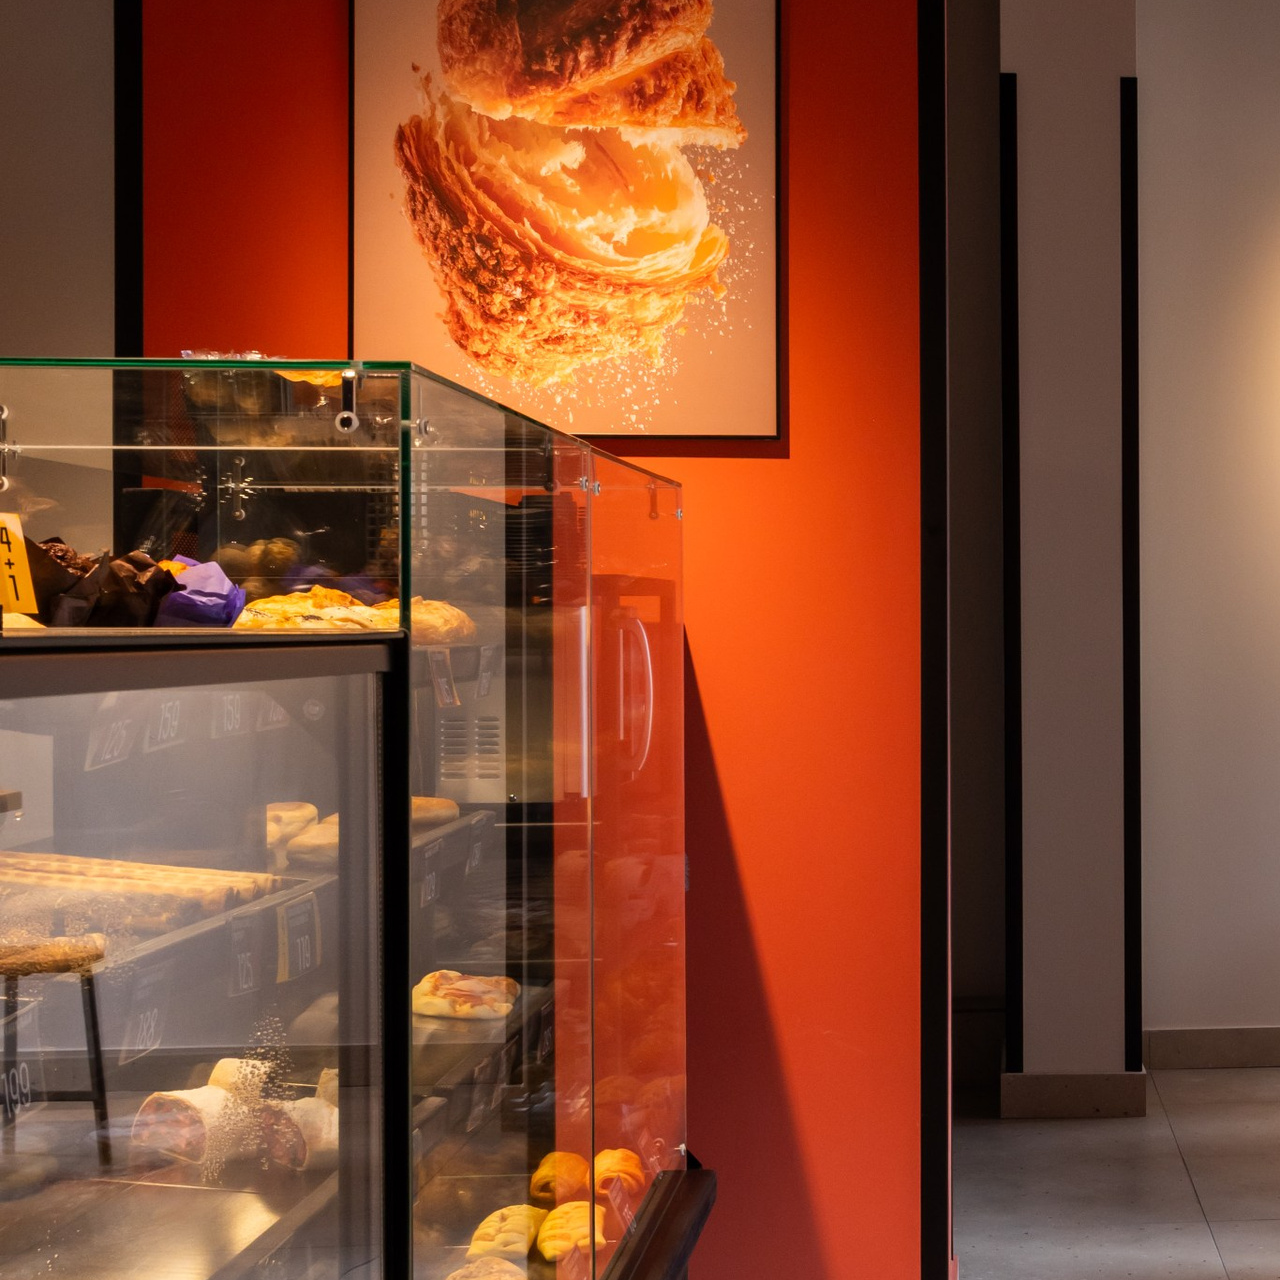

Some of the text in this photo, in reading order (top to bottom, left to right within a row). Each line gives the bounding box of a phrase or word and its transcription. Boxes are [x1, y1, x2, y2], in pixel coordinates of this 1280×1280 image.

[157, 700, 181, 742] 159
[223, 694, 240, 732] 159
[296, 934, 311, 971] 119
[1, 1061, 31, 1118] 199
